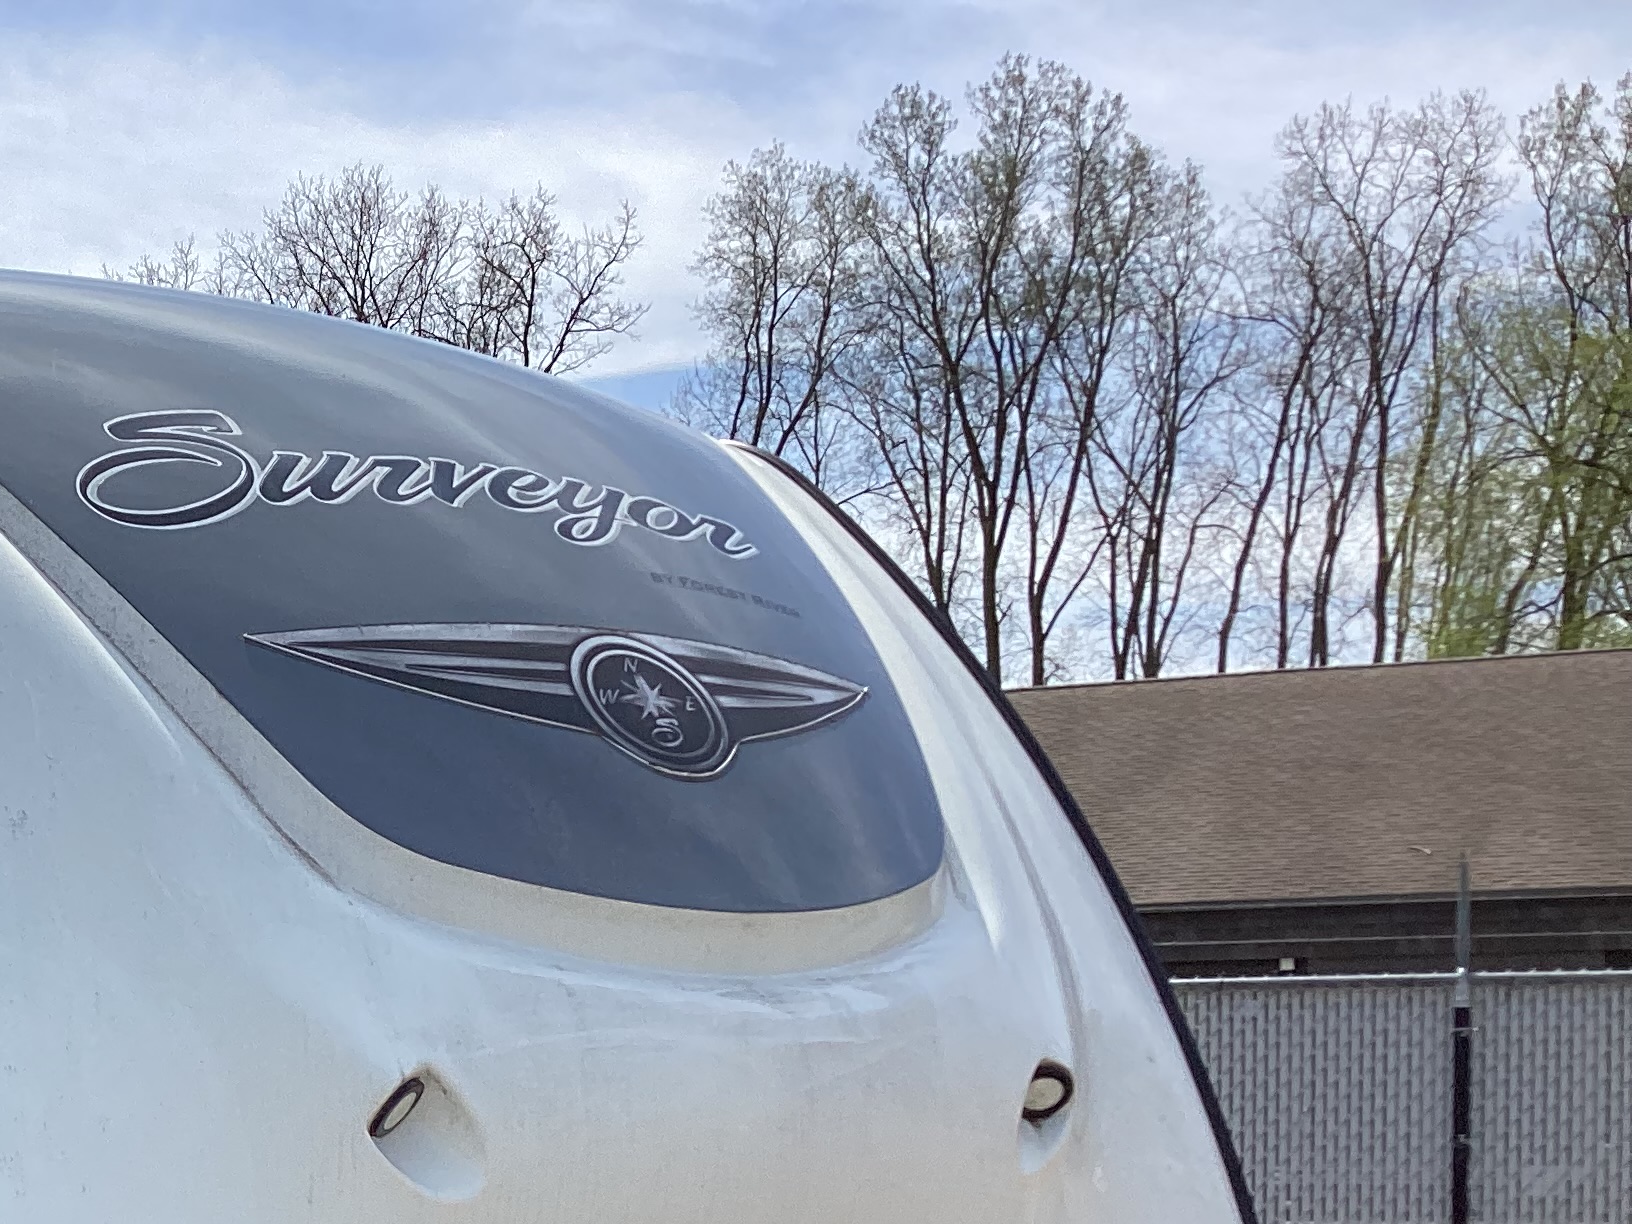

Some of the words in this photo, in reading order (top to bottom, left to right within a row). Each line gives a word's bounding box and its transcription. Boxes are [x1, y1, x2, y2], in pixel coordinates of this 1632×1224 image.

[76, 408, 760, 560] Surveyor
[623, 657, 639, 674] N
[599, 688, 620, 706] W
[685, 695, 697, 712] E
[651, 717, 684, 748] S
